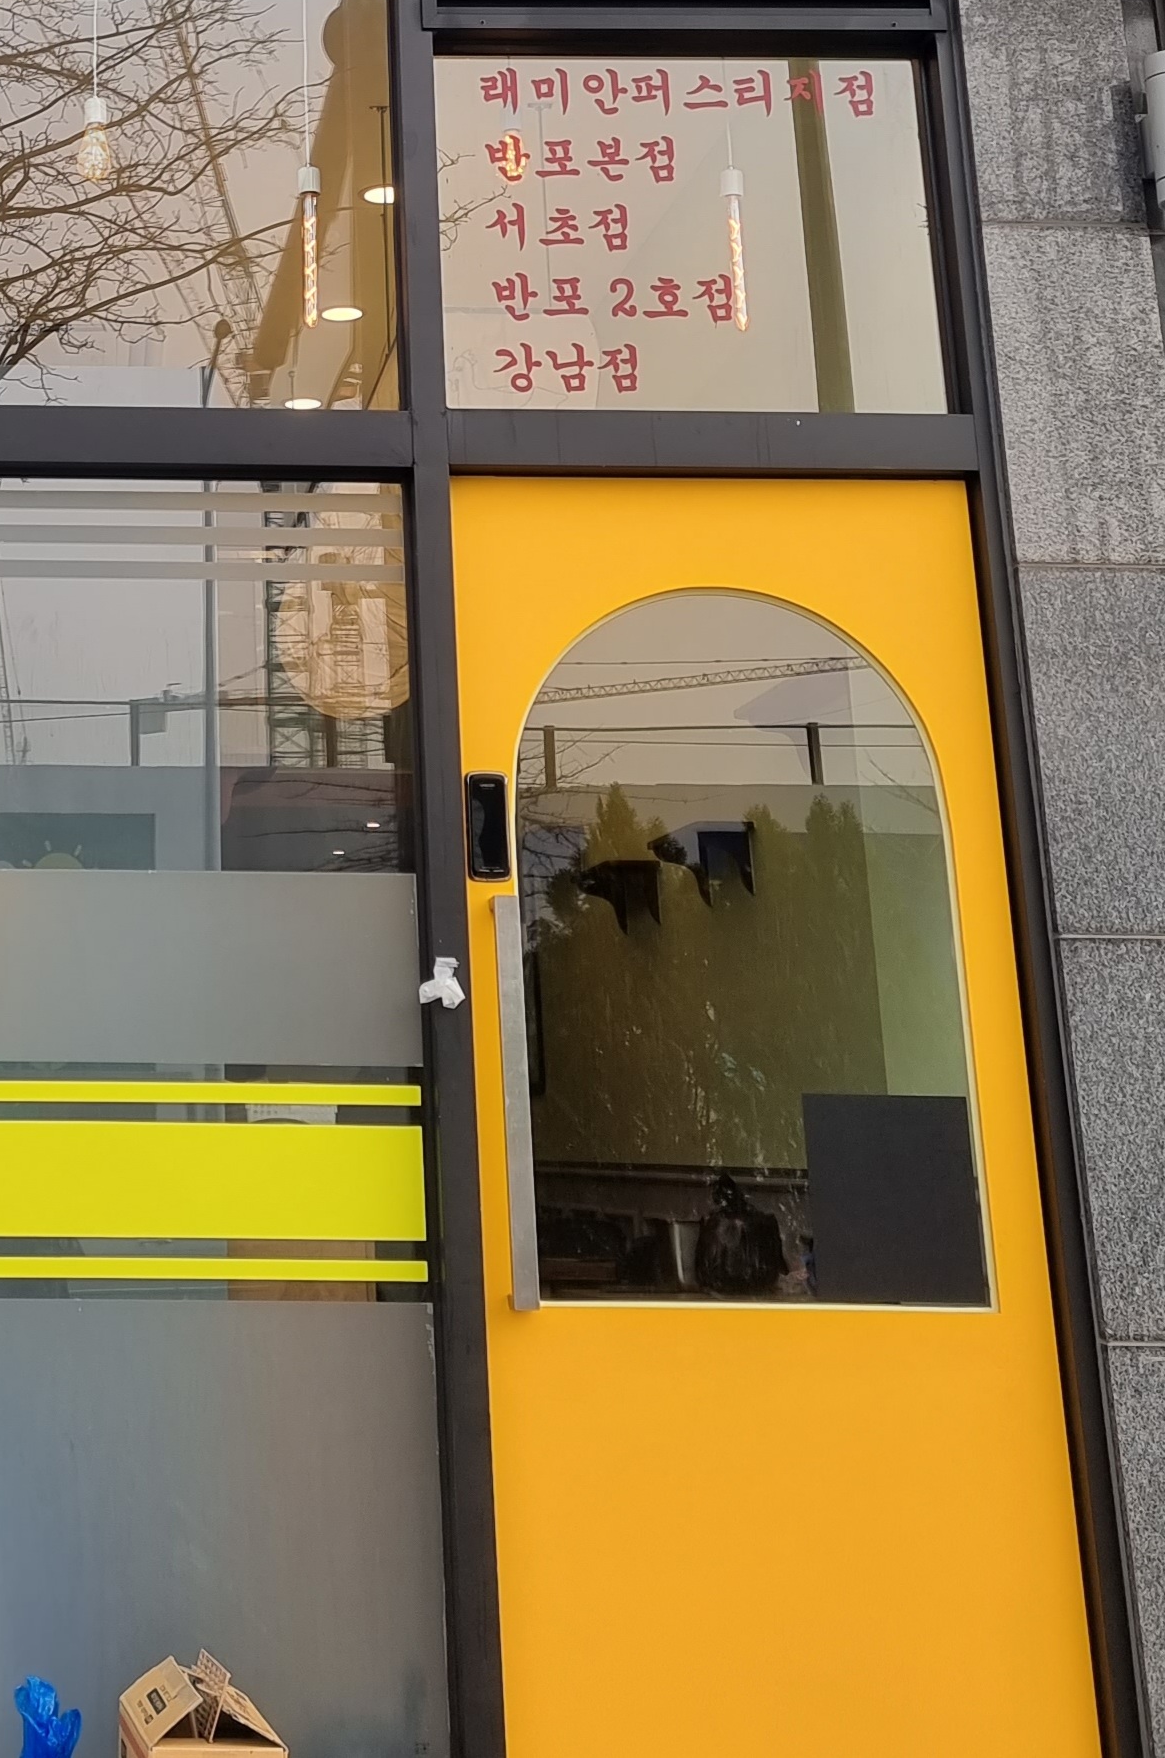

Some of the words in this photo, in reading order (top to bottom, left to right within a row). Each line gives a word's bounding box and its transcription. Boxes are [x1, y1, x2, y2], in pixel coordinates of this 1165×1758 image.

[479, 67, 875, 118] 래미안퍼스티지점
[484, 134, 677, 184] 반포본점
[486, 202, 630, 253] 서초점
[491, 272, 591, 323] 반포
[608, 274, 735, 324] 2호점
[493, 342, 639, 395] 강남점
